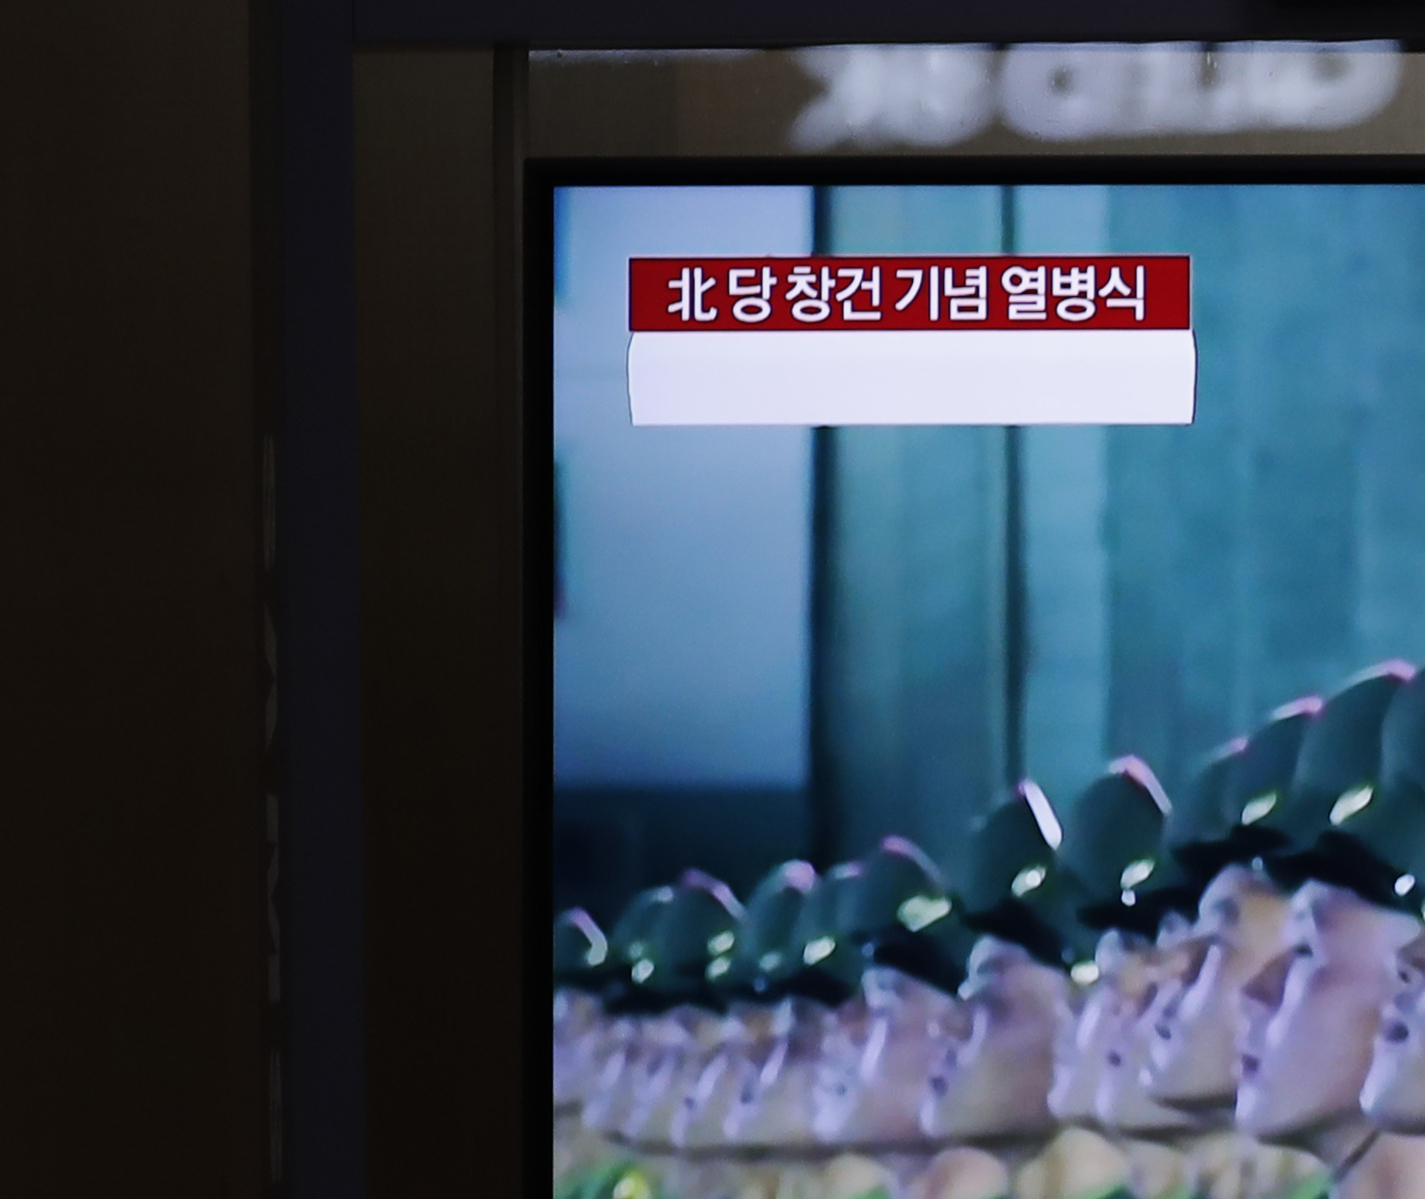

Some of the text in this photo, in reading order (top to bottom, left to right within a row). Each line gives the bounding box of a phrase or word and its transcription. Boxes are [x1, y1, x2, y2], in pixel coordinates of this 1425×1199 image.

[667, 265, 1146, 323] 北 당 창건 기념 열병식
